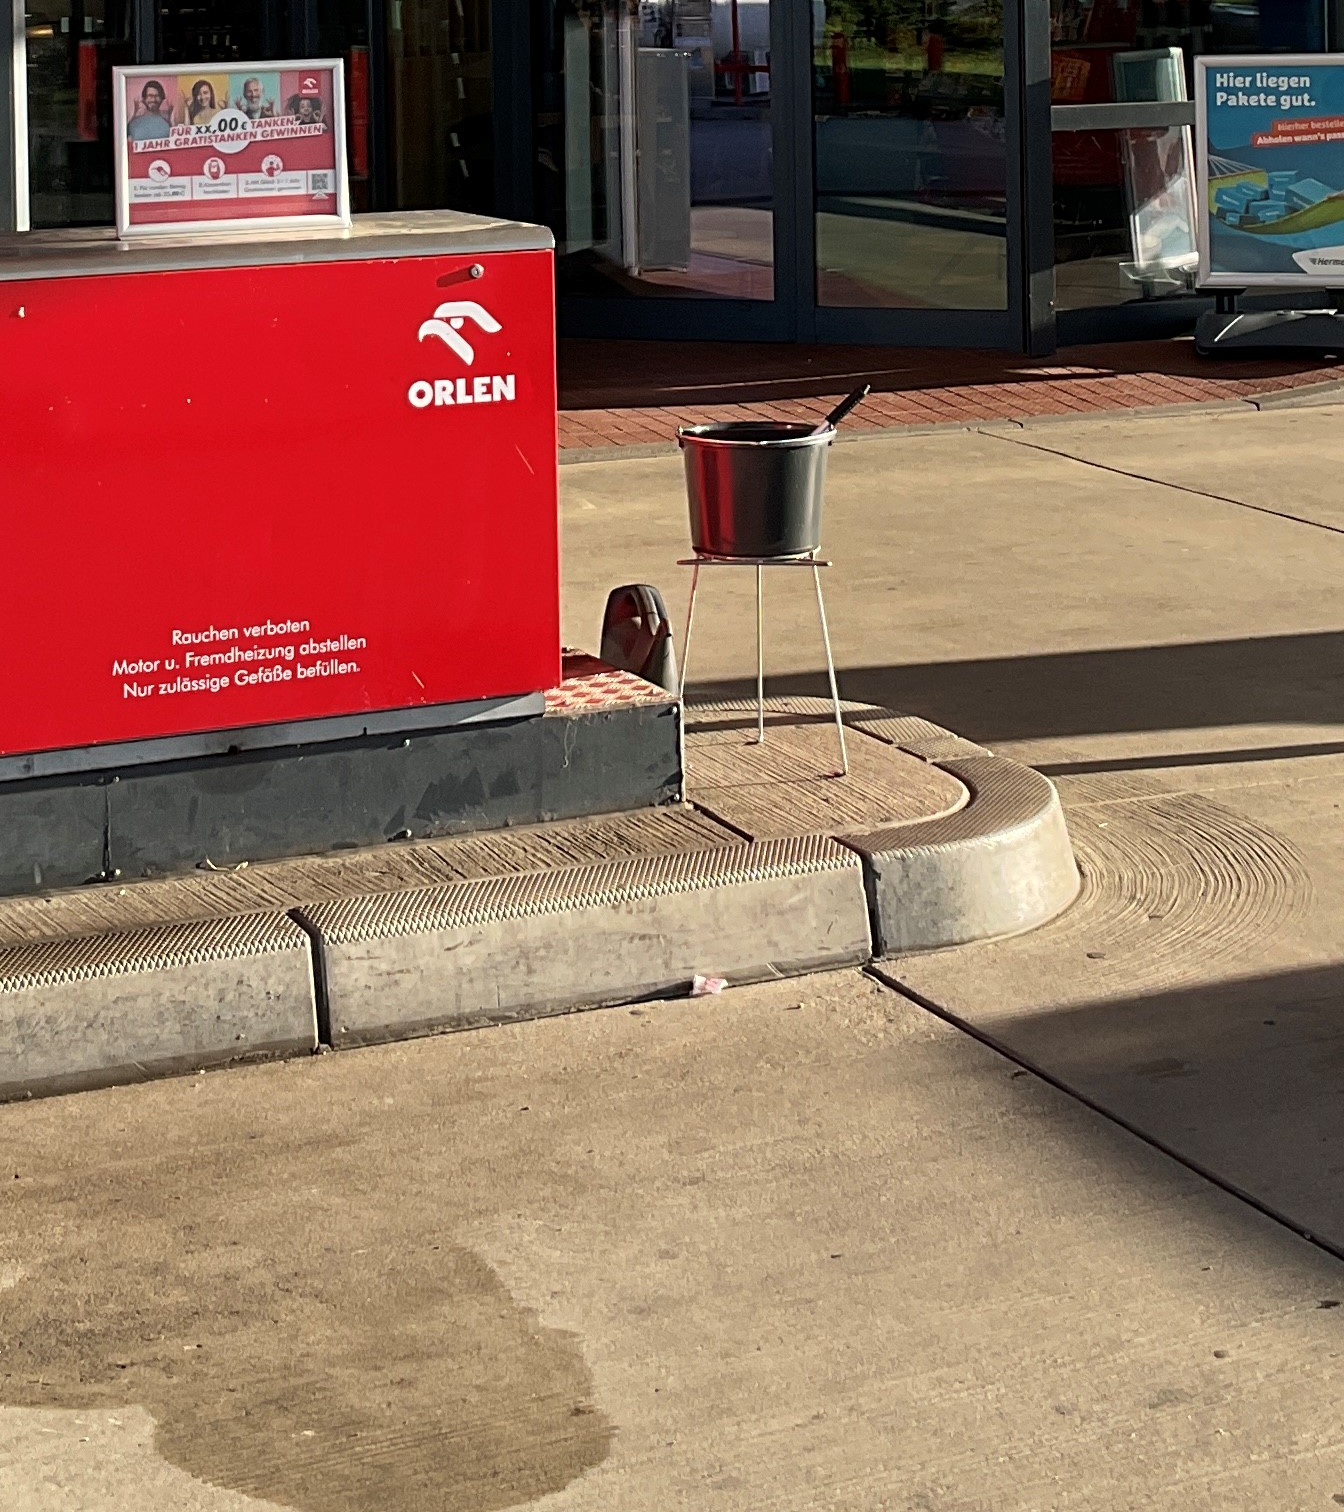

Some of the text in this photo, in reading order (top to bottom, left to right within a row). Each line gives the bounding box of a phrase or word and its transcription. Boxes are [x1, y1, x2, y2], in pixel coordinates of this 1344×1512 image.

[1216, 72, 1310, 91] Hier liegen
[1216, 91, 1316, 110] Pakete gut.
[141, 139, 171, 151] JAHR
[174, 130, 258, 148] GRATISTANKEN
[261, 125, 322, 138] GEWINNEN
[171, 126, 192, 137] FÜR
[1257, 134, 1293, 145] Abholen
[407, 374, 515, 408] ORLEN
[172, 618, 310, 646] Rauchen verboten
[112, 634, 367, 677] Motor u. Fremdheizung abstellen
[123, 658, 361, 699] Nur zulässige Gefäße befüllen.
